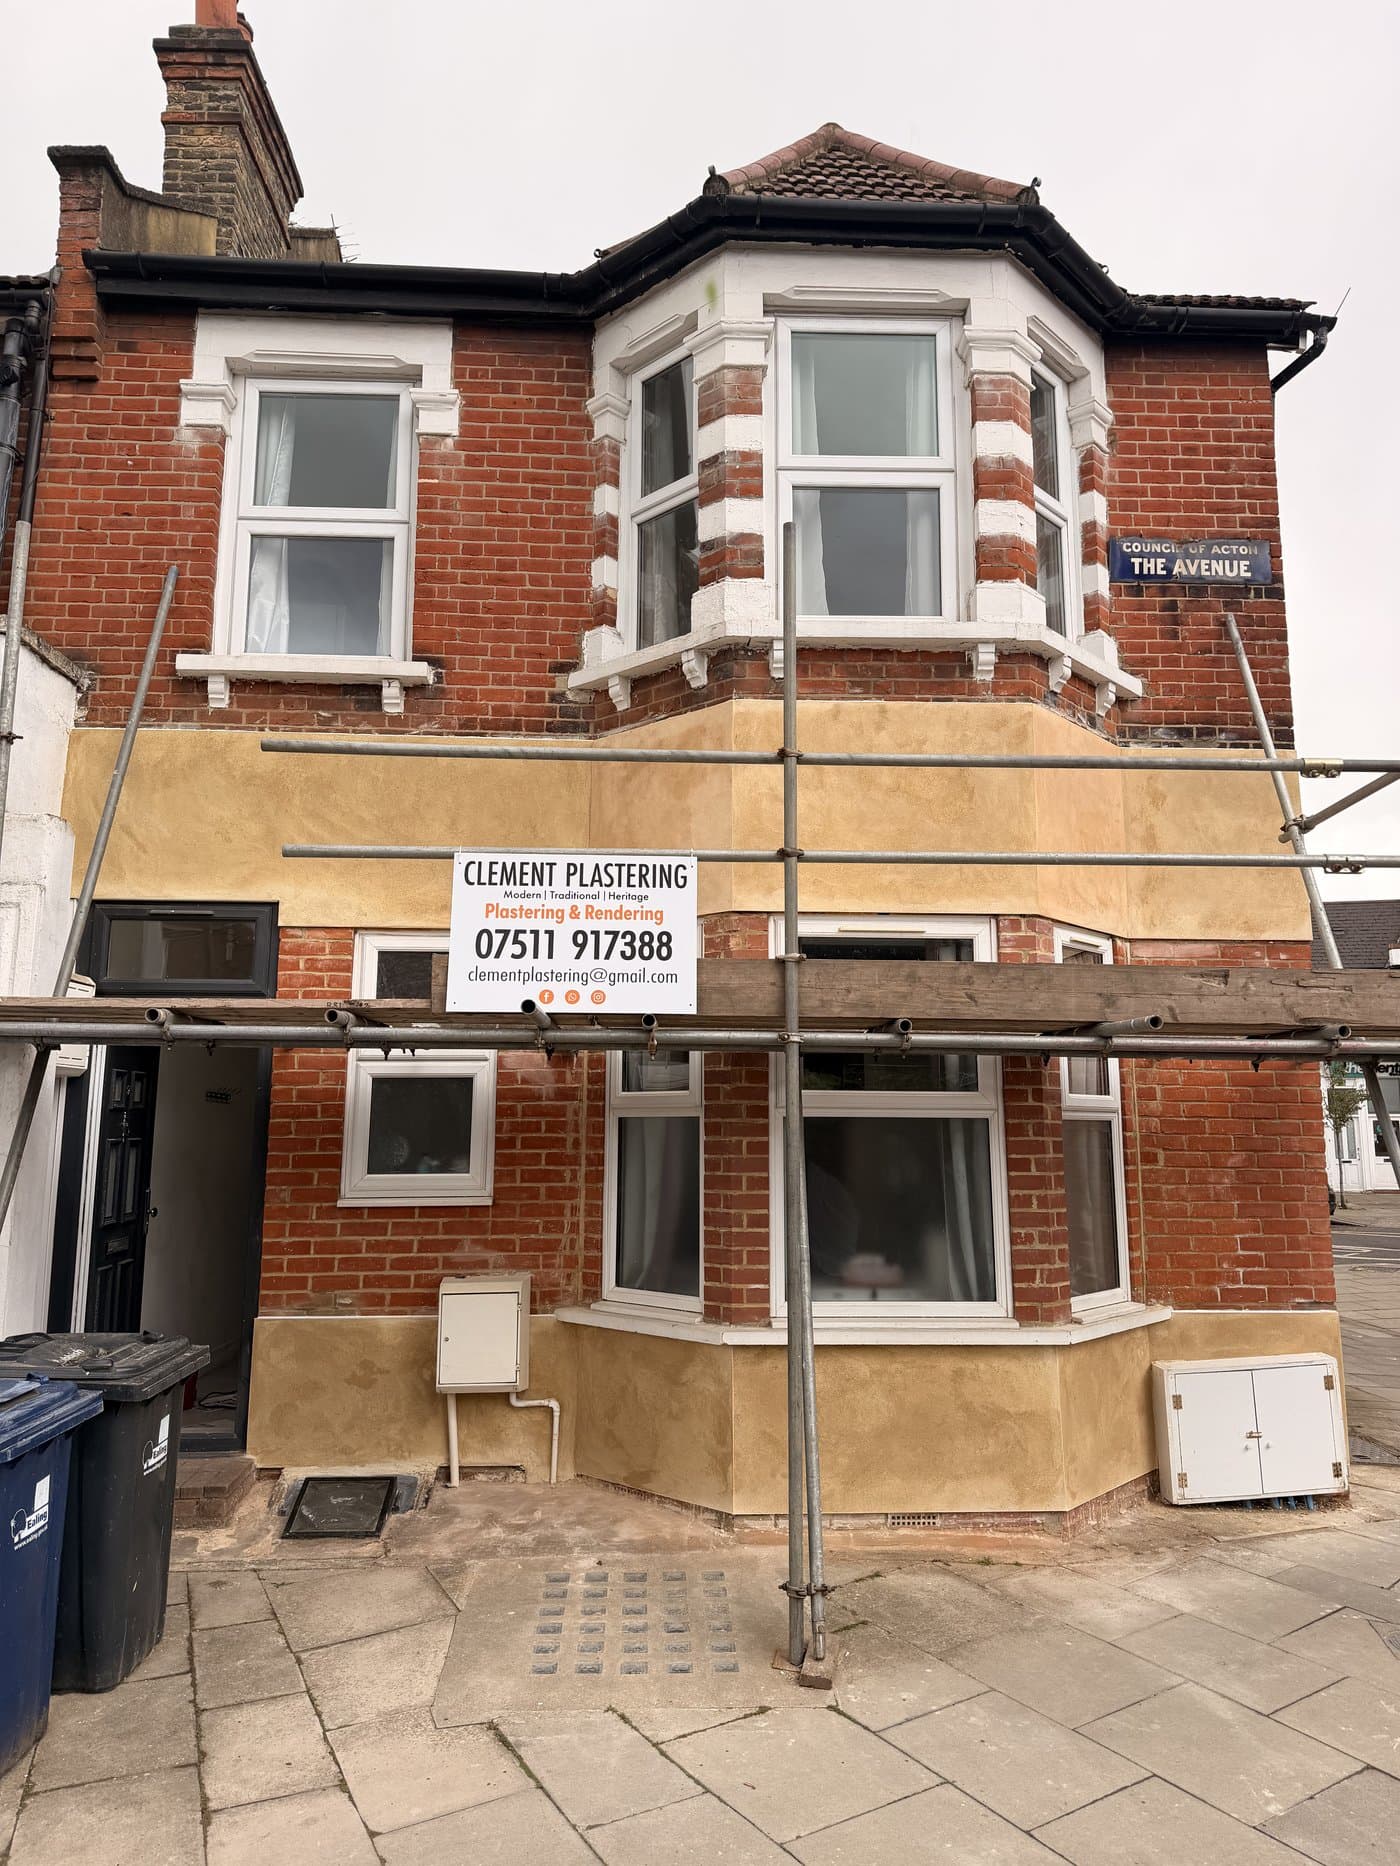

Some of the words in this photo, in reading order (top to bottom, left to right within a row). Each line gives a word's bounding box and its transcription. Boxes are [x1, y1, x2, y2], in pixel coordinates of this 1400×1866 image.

[1189, 545, 1206, 553] OF
[1211, 545, 1258, 555] ACTON
[1130, 557, 1167, 576] THE
[1172, 558, 1252, 577] AVENUE
[464, 860, 557, 887] CLEMENT
[566, 862, 688, 889] PLASTERING
[503, 890, 542, 900] Modern
[550, 890, 600, 900] Traditional
[608, 892, 649, 902] Heritage
[485, 903, 565, 924] Plastering
[569, 905, 581, 920] &
[584, 906, 664, 926] Rendering
[475, 928, 555, 960] 07511
[572, 929, 673, 961] 917388
[468, 966, 678, 987] clementplastering@gmail.com
[27, 1511, 48, 1529] Ealing
